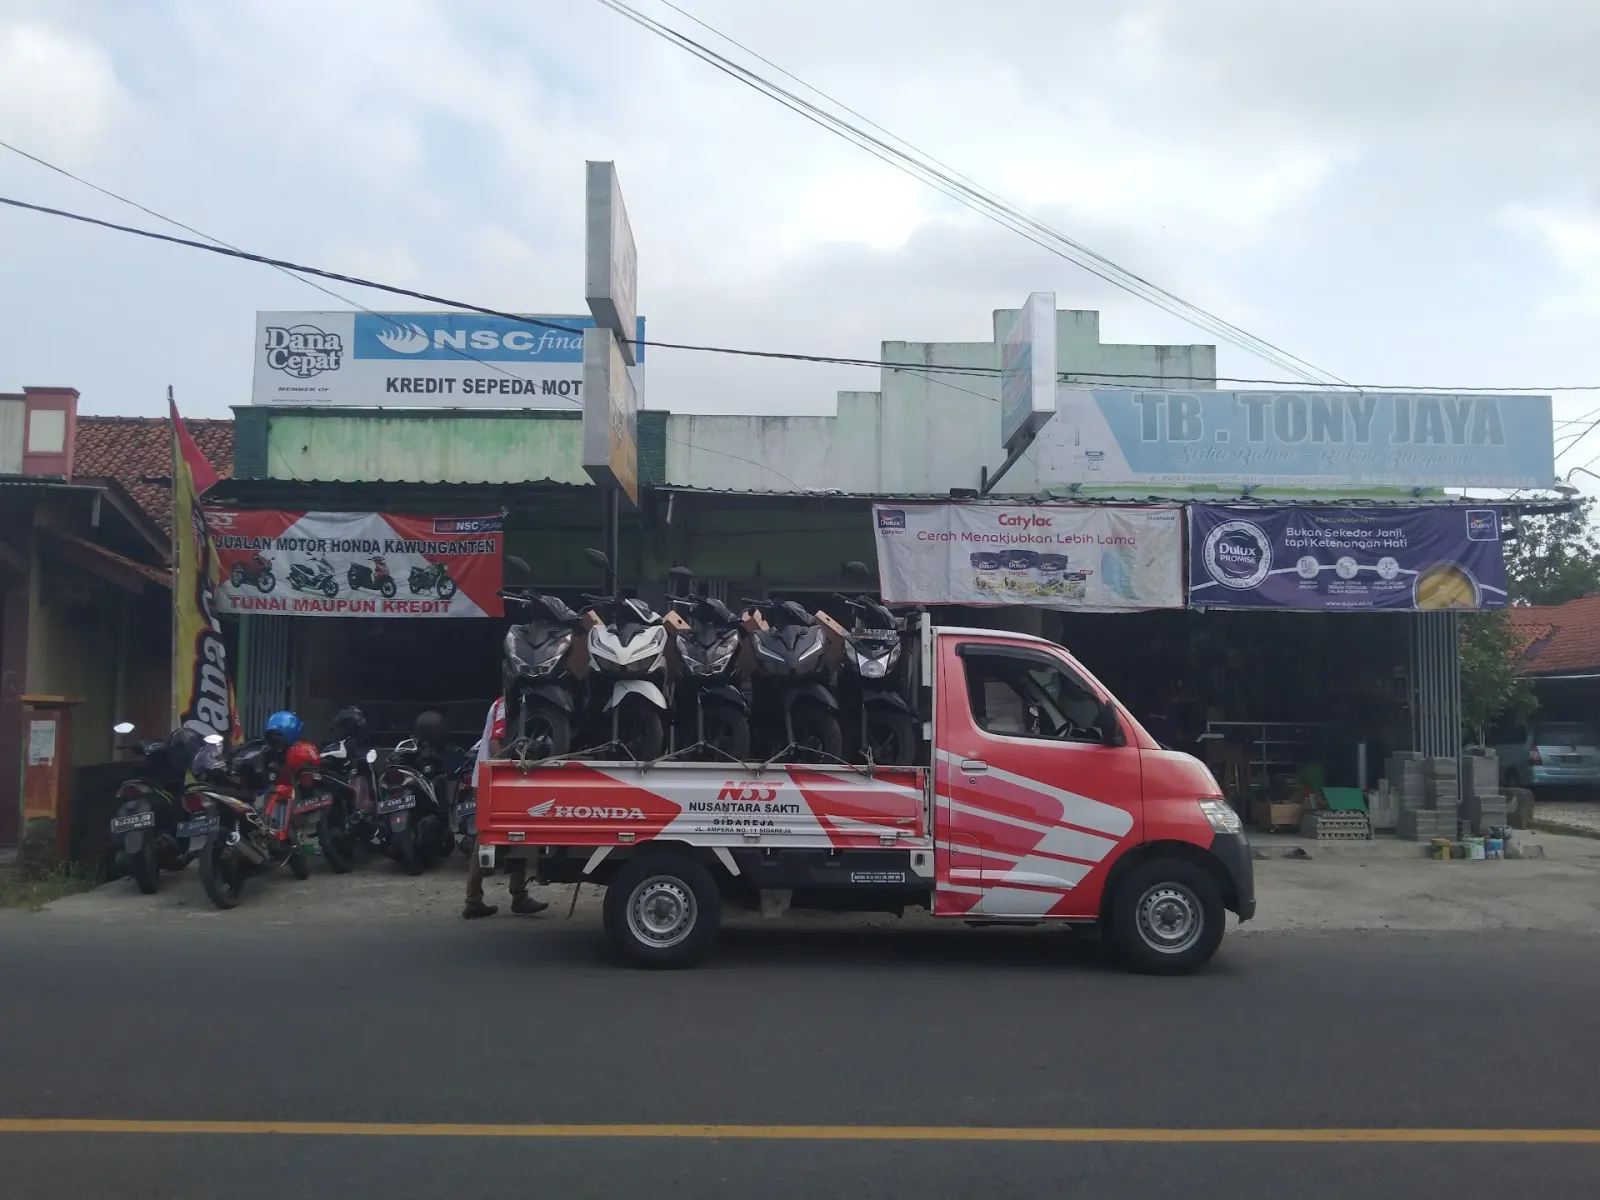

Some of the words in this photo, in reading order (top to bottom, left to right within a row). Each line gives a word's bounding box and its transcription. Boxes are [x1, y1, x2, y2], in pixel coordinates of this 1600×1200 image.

[265, 326, 342, 350] Dana
[434, 330, 535, 352] NSC
[533, 329, 583, 355] fina
[267, 348, 340, 377] Cepat
[386, 377, 457, 395] KREDIT
[462, 378, 536, 395] SEPEDA
[542, 379, 583, 396] MOT
[1235, 392, 1378, 445] TONY
[1388, 394, 1507, 447] JAYA
[455, 521, 479, 531] NSC
[880, 519, 901, 527] Dulux
[997, 513, 1052, 530] Catylac
[917, 531, 957, 542] Cerah
[961, 531, 1053, 546] Menakjubkan
[1056, 533, 1094, 545] Lebih
[1097, 535, 1136, 546] Lama
[1286, 527, 1322, 538] Bukan
[1324, 528, 1373, 539] Sekedar
[1376, 528, 1406, 540] Janji,
[212, 535, 271, 550] JUALAN
[277, 537, 326, 552] MOTOR
[332, 538, 382, 553] HONDA
[385, 539, 495, 554] KAWUNGANTEN
[1219, 542, 1256, 556] Dulux
[1286, 538, 1307, 550] tapi
[1310, 538, 1381, 551] Ketenangan
[1383, 539, 1408, 549] Hati
[1220, 554, 1257, 564] PROMISE
[230, 596, 287, 611] TUNAI
[293, 597, 377, 614] MAUPUN
[382, 599, 453, 614] KREDIT
[553, 805, 646, 820] HONDA
[689, 802, 760, 813] NUSANTARA
[765, 803, 800, 814] SAKTI
[713, 818, 774, 826] SIDAREJA
